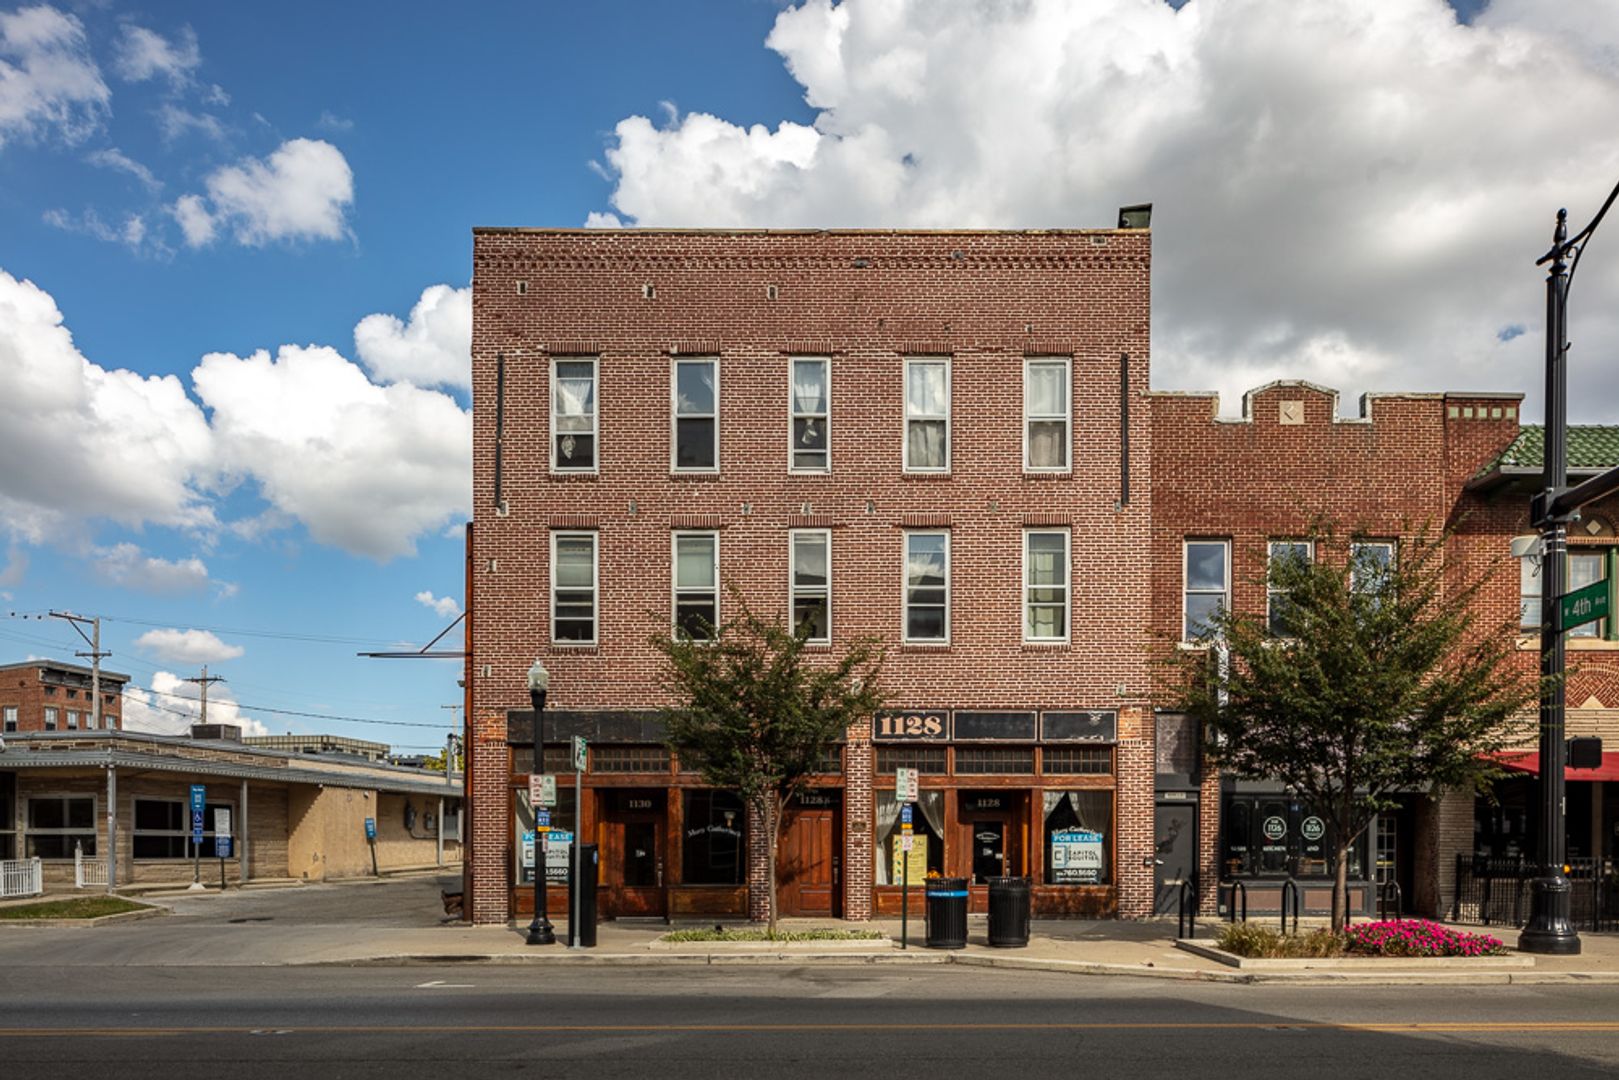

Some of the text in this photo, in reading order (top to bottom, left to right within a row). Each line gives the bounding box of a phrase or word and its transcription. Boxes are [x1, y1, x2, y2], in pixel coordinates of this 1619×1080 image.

[1572, 597, 1592, 616] 4th
[880, 716, 943, 735] 1128
[629, 799, 653, 808] 1130
[977, 799, 1001, 807] 1128
[1073, 834, 1101, 842] LEASE
